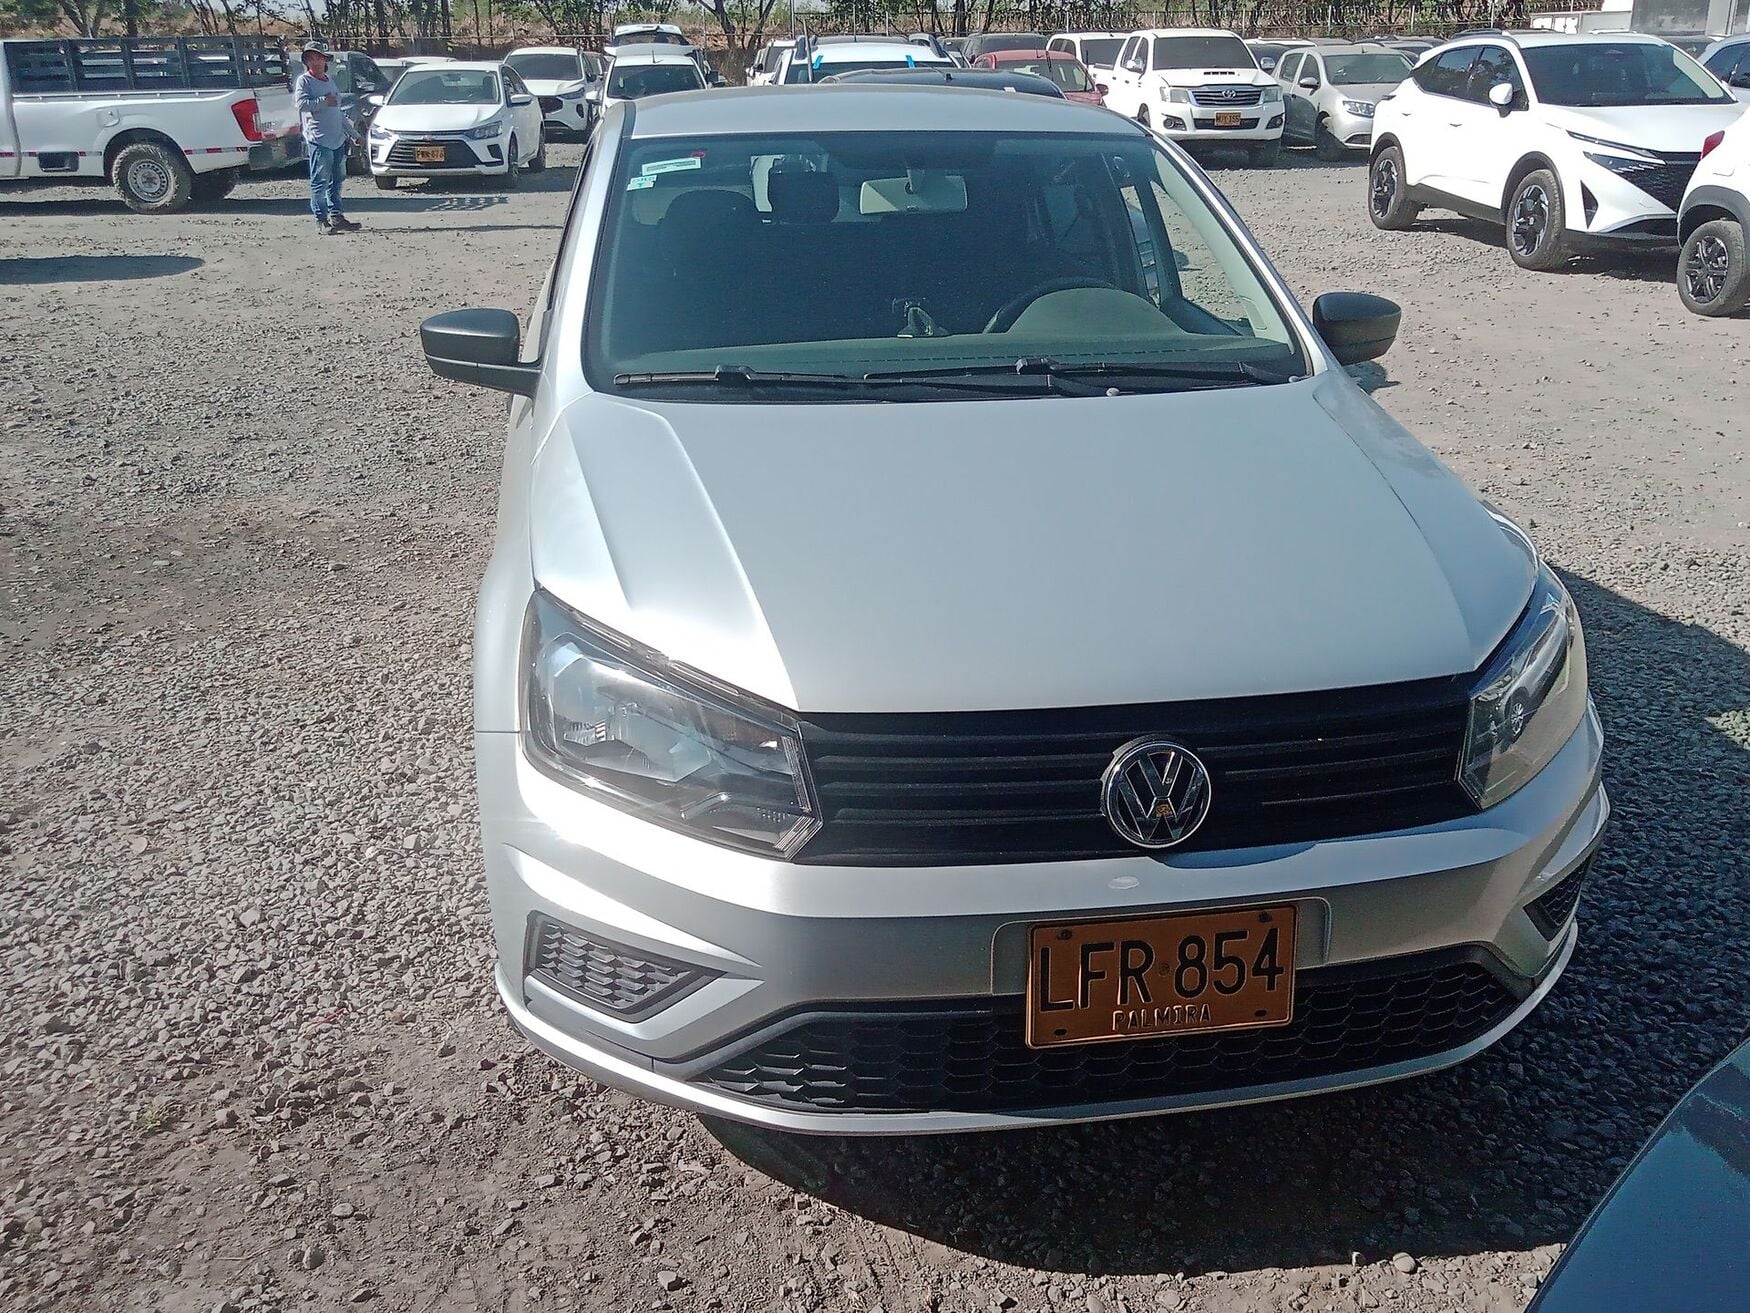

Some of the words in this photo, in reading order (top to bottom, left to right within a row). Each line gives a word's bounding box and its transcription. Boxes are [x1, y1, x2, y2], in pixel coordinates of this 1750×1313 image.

[1040, 939, 1155, 1012] LFR
[1174, 927, 1285, 999] 854
[1112, 1003, 1212, 1031] PALMIRA
